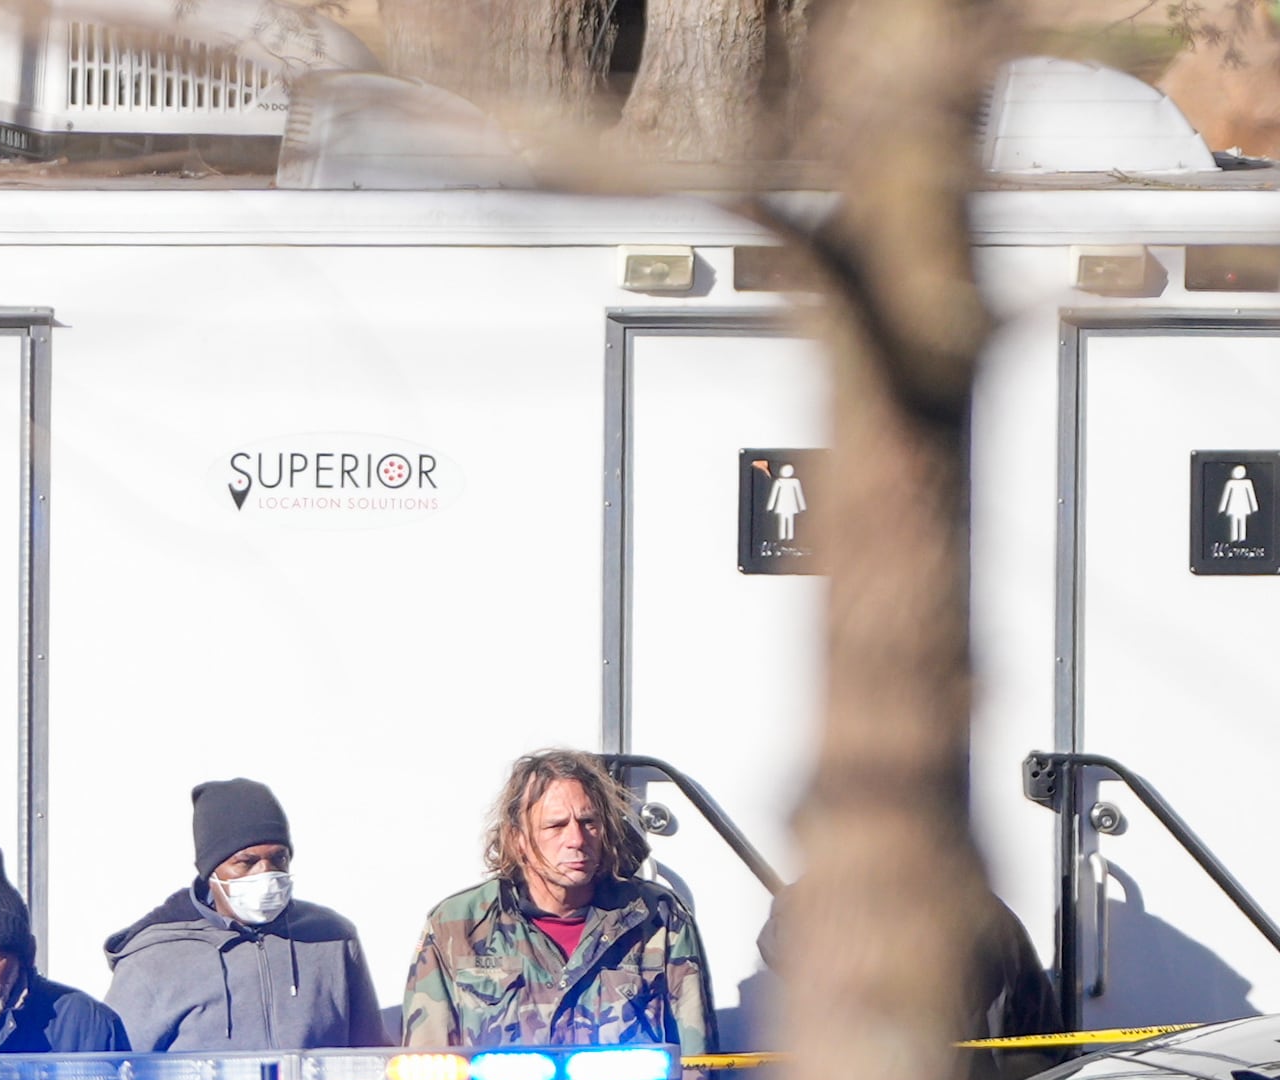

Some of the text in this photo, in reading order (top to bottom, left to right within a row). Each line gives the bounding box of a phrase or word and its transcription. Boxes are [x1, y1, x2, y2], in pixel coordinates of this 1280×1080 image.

[228, 452, 437, 500] SUPERIOR
[258, 497, 439, 510] LOCATION SOLUTIONS
